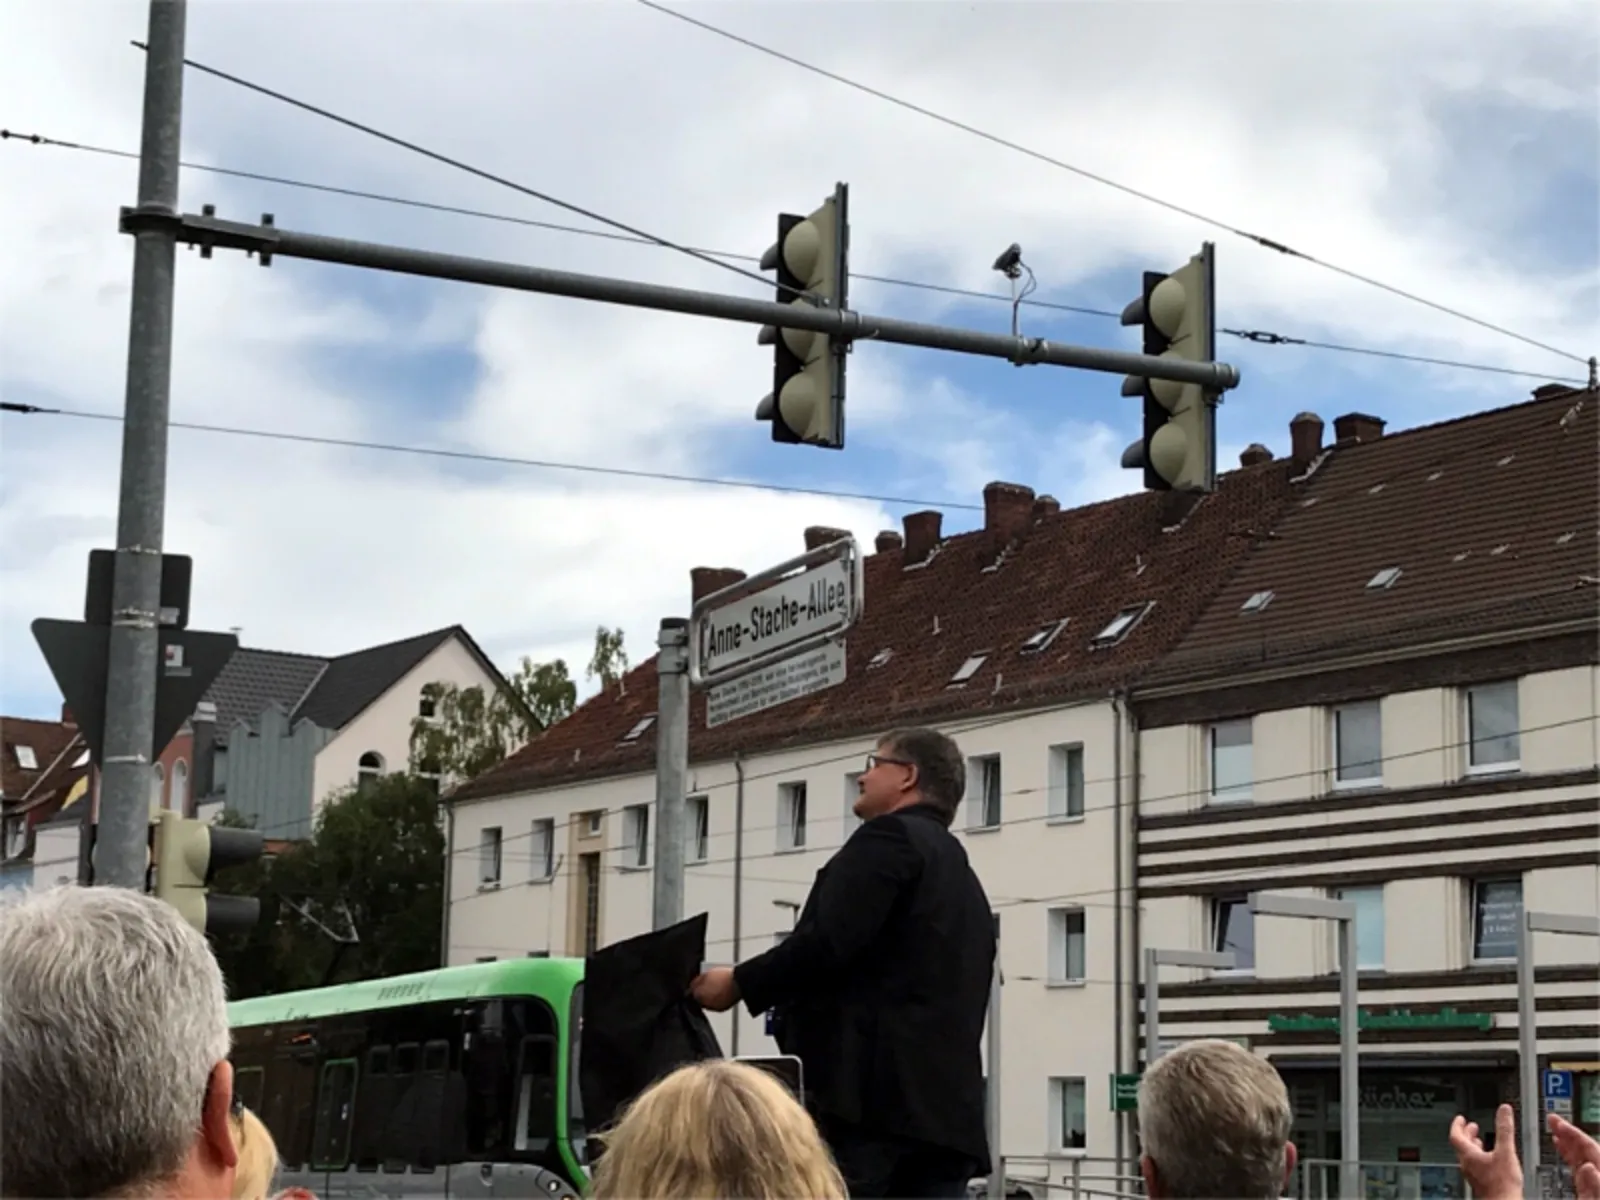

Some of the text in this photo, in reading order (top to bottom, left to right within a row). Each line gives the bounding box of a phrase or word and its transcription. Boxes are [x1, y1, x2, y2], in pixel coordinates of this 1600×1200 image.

[708, 577, 846, 659] Anne-Stache-Allee
[1359, 1084, 1435, 1109] ücher
[1547, 1073, 1563, 1095] P
